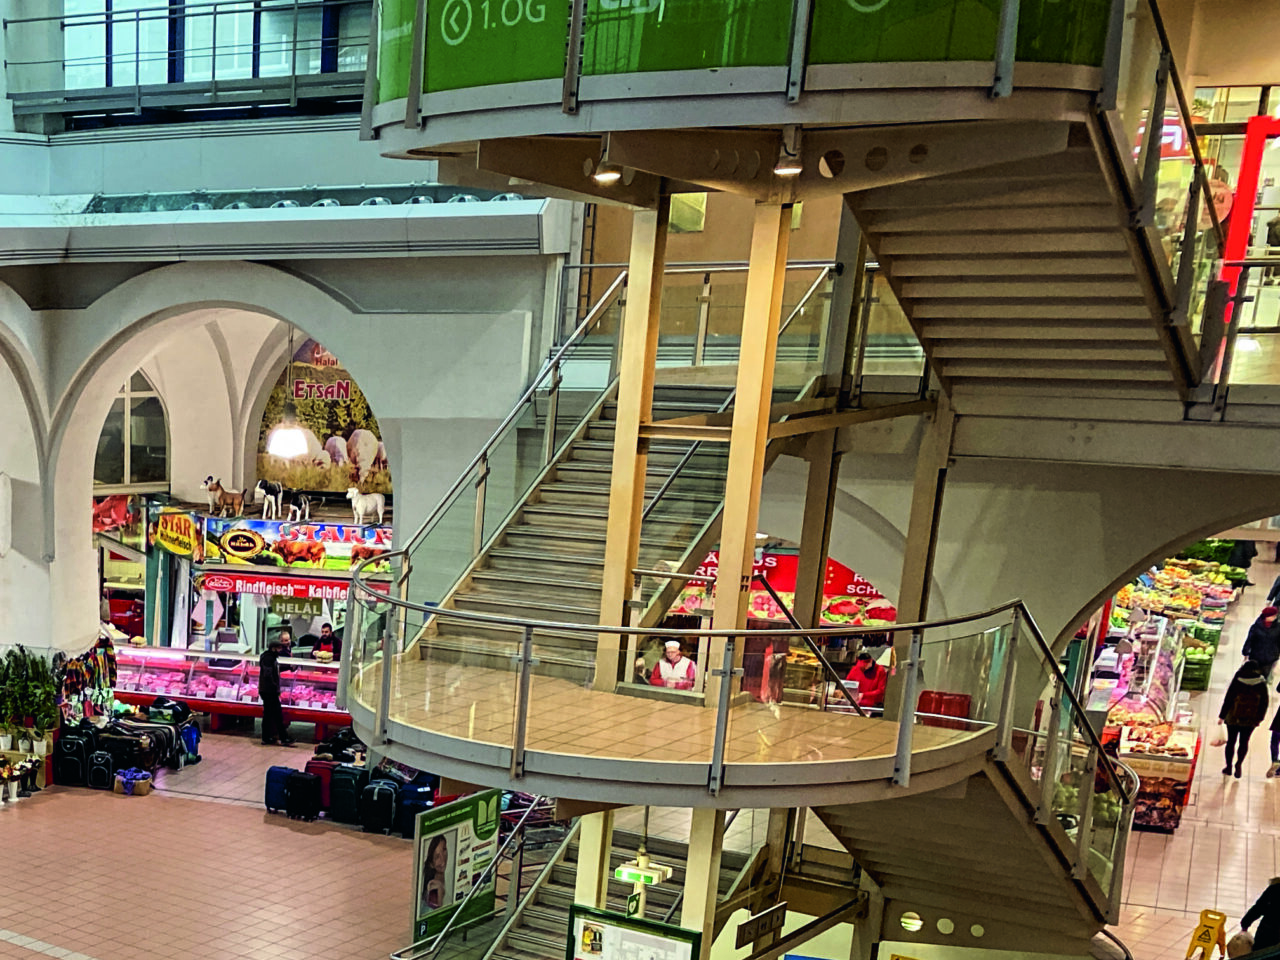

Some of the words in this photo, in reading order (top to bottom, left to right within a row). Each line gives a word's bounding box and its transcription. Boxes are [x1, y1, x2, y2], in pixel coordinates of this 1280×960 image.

[315, 358, 338, 366] Halal
[160, 515, 192, 538] STAR
[280, 525, 365, 544] STAR
[235, 580, 294, 597] Rindfleisch
